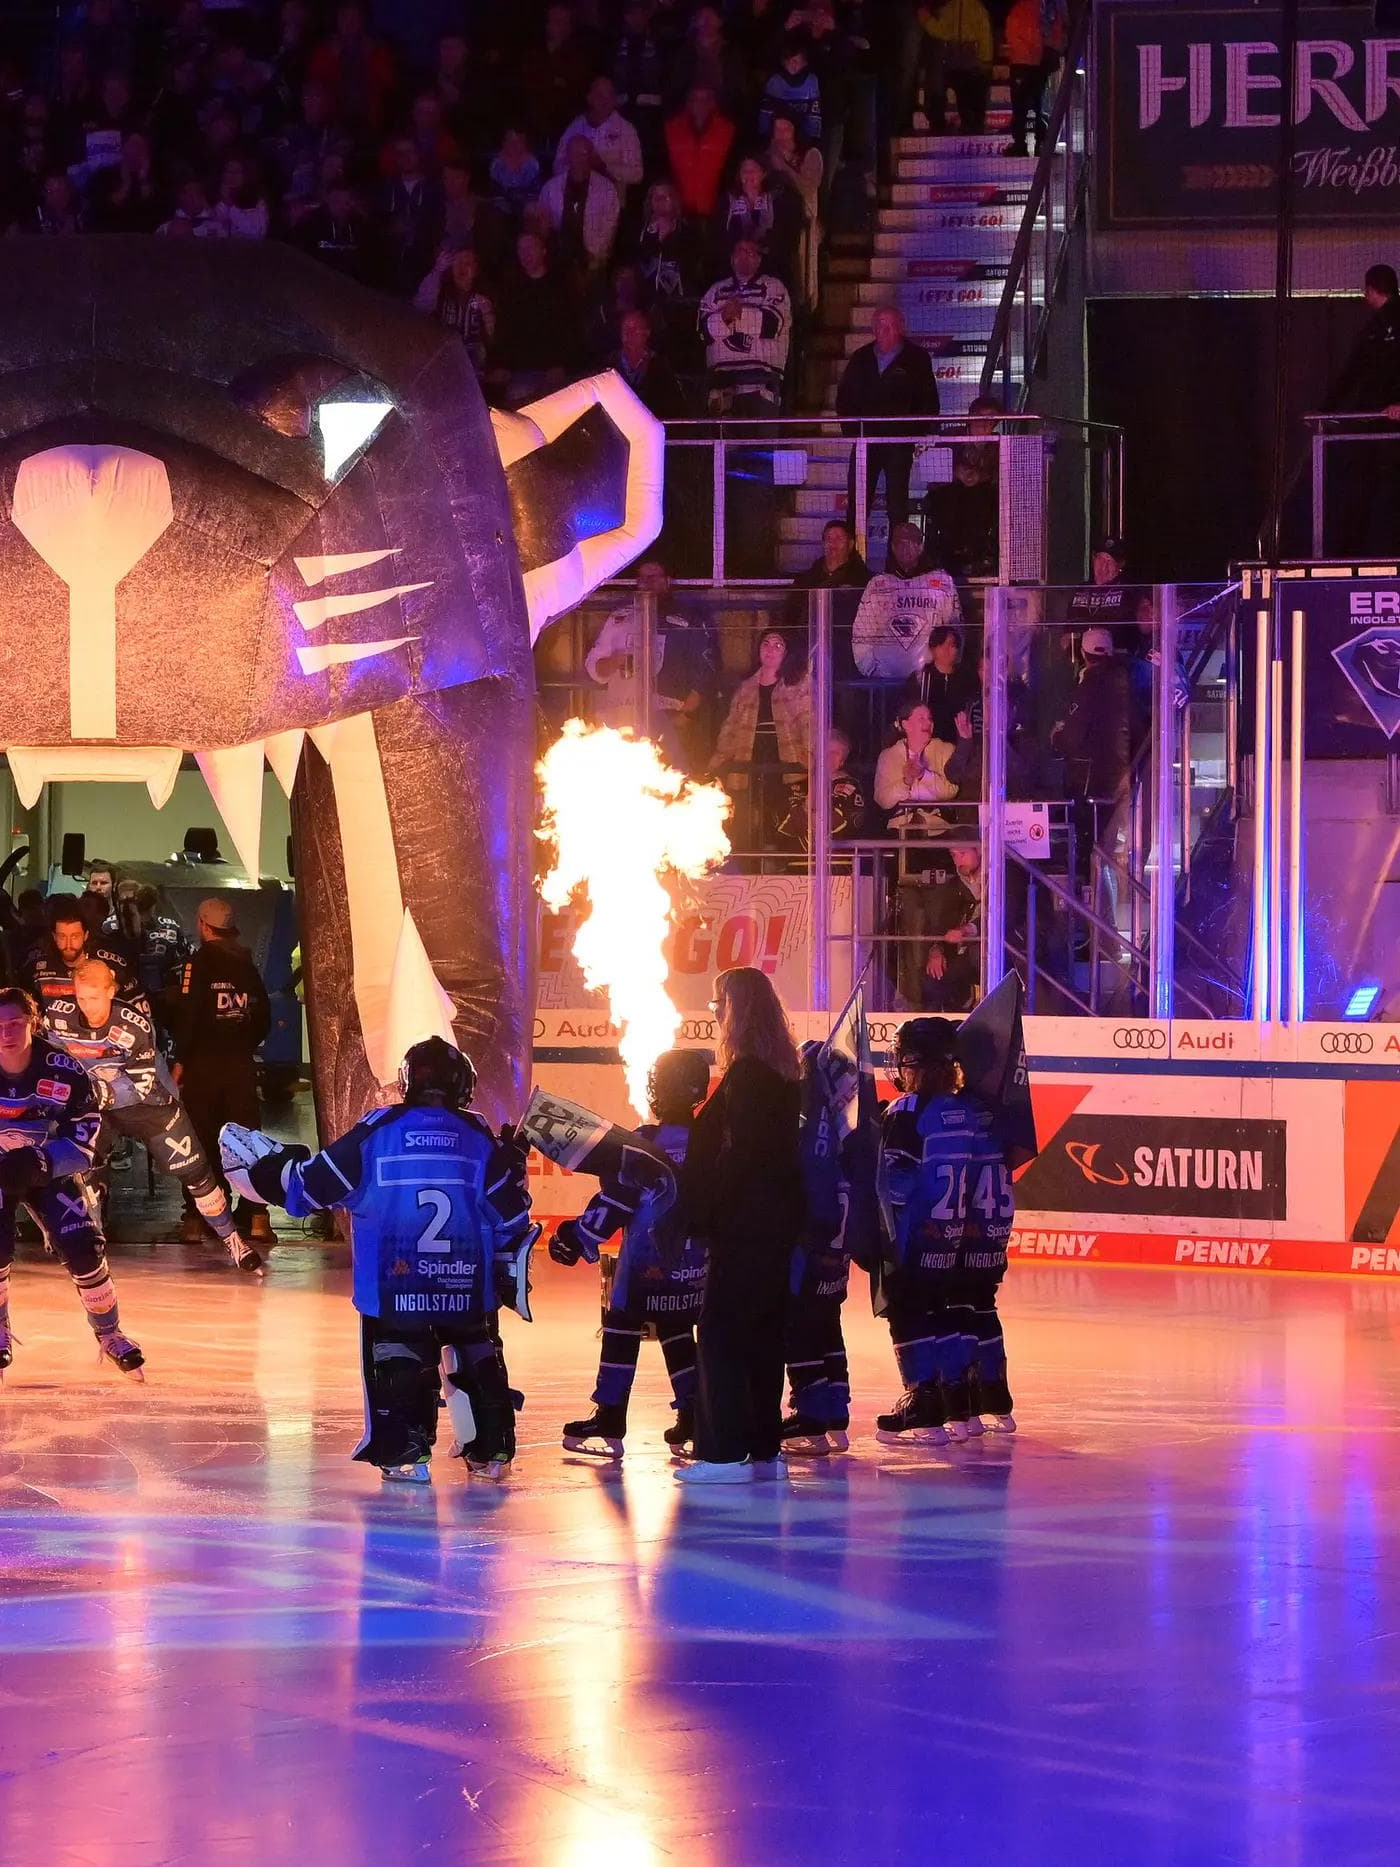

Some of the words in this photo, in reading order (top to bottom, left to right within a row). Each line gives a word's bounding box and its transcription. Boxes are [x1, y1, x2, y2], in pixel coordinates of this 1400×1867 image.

[673, 914, 788, 975] GO!
[1177, 1031, 1235, 1050] Audi
[404, 1131, 459, 1147] SCHMIDT
[1133, 1145, 1263, 1191] SATURN
[417, 1188, 452, 1254] 2
[417, 1259, 478, 1278] Spindler
[394, 1294, 472, 1313] INGOLSTADT
